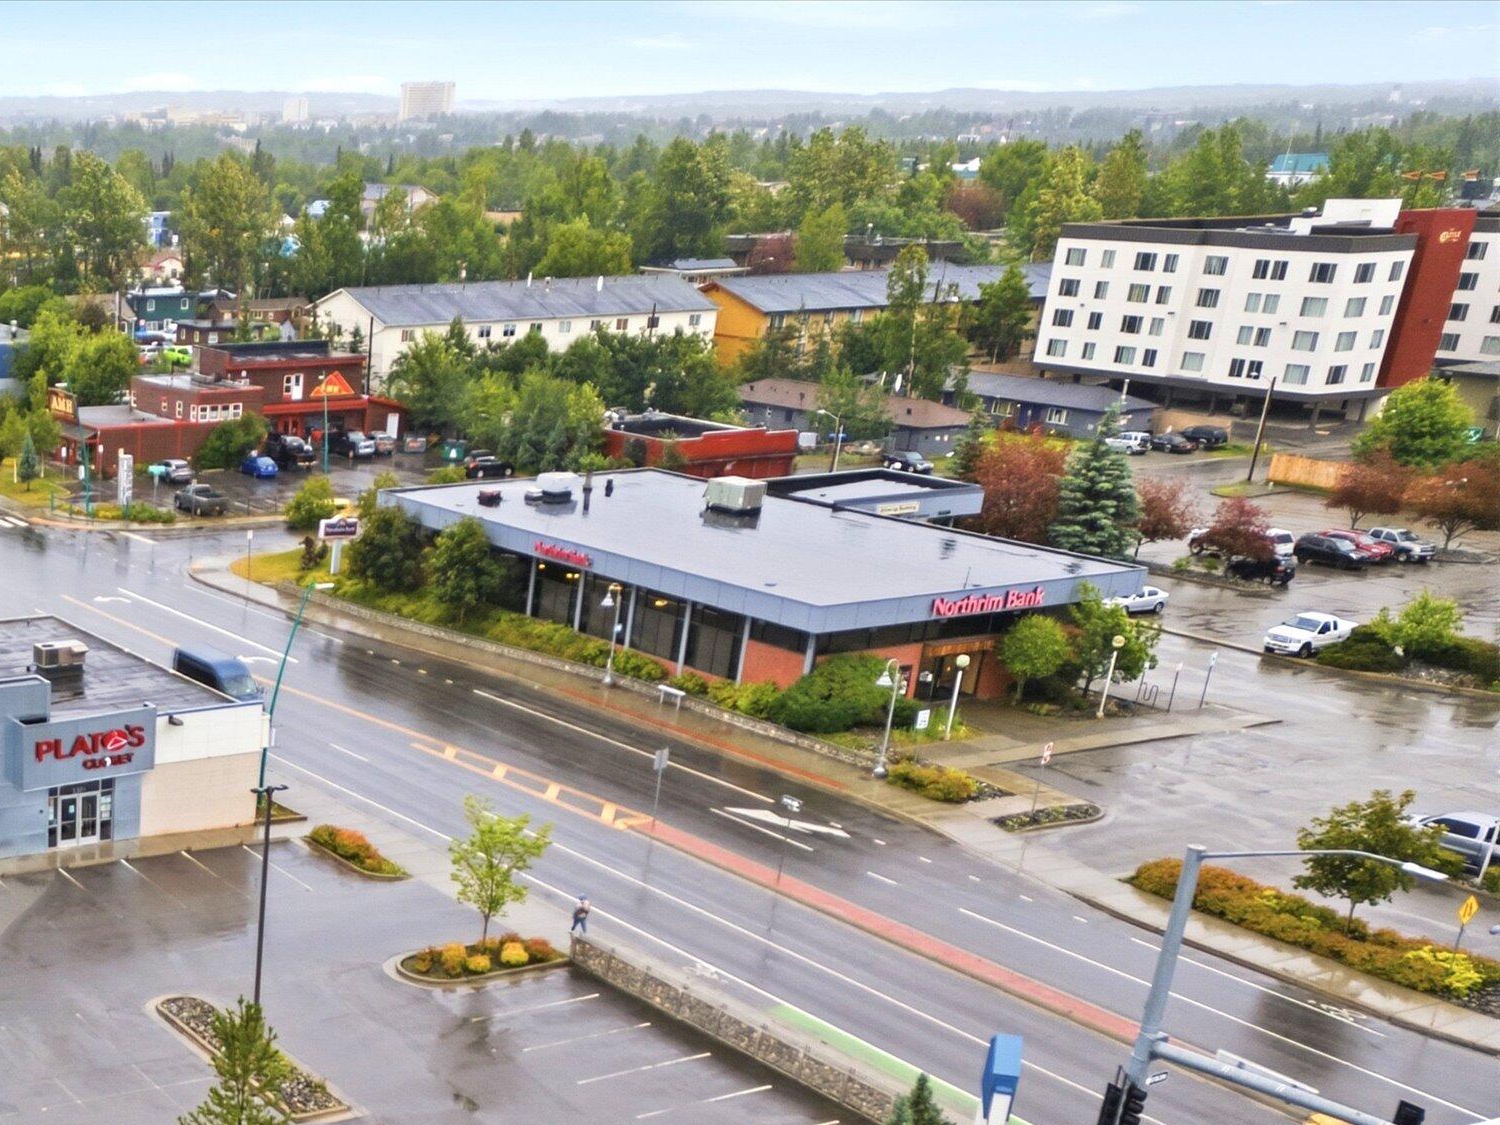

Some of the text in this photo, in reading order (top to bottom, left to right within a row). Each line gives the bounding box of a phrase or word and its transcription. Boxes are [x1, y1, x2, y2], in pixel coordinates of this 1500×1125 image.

[931, 586, 1045, 617] Northrim Bank
[34, 725, 146, 763] PLATO'S
